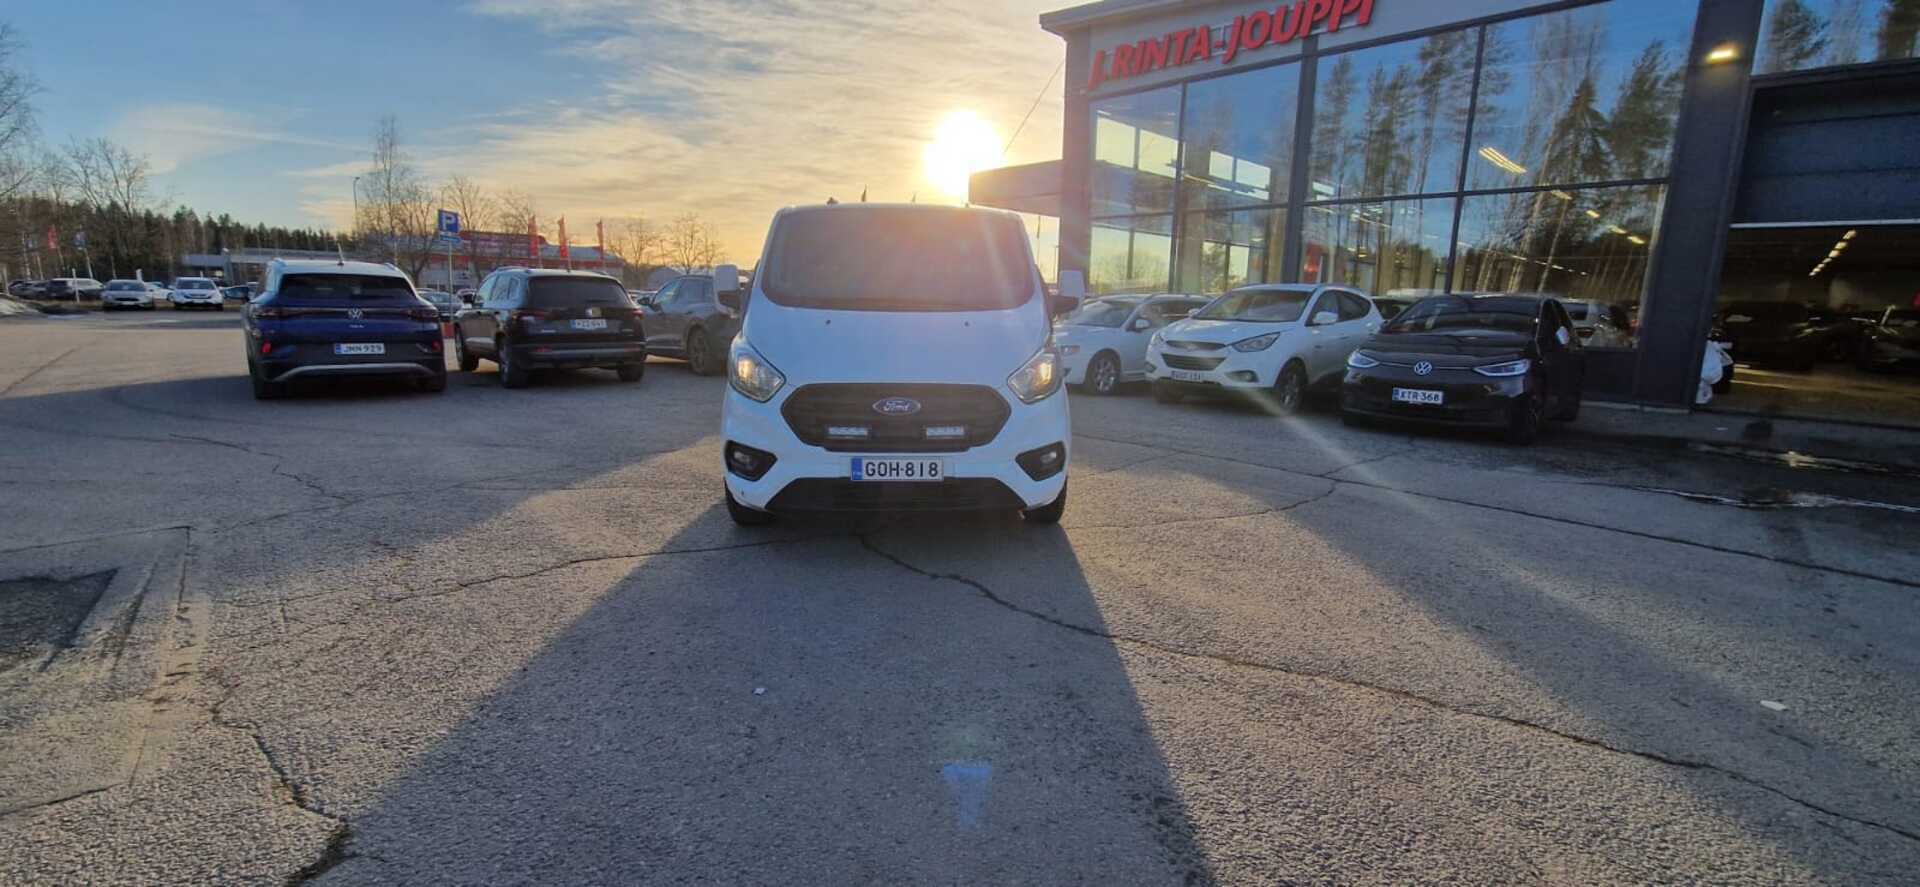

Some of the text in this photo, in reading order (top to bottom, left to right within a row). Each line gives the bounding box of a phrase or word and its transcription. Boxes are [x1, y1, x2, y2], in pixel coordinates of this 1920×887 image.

[1111, 0, 1375, 80] RINTA-JOUPPI
[442, 214, 456, 230] P
[882, 400, 911, 412] Ford
[865, 461, 939, 477] GOH-818
